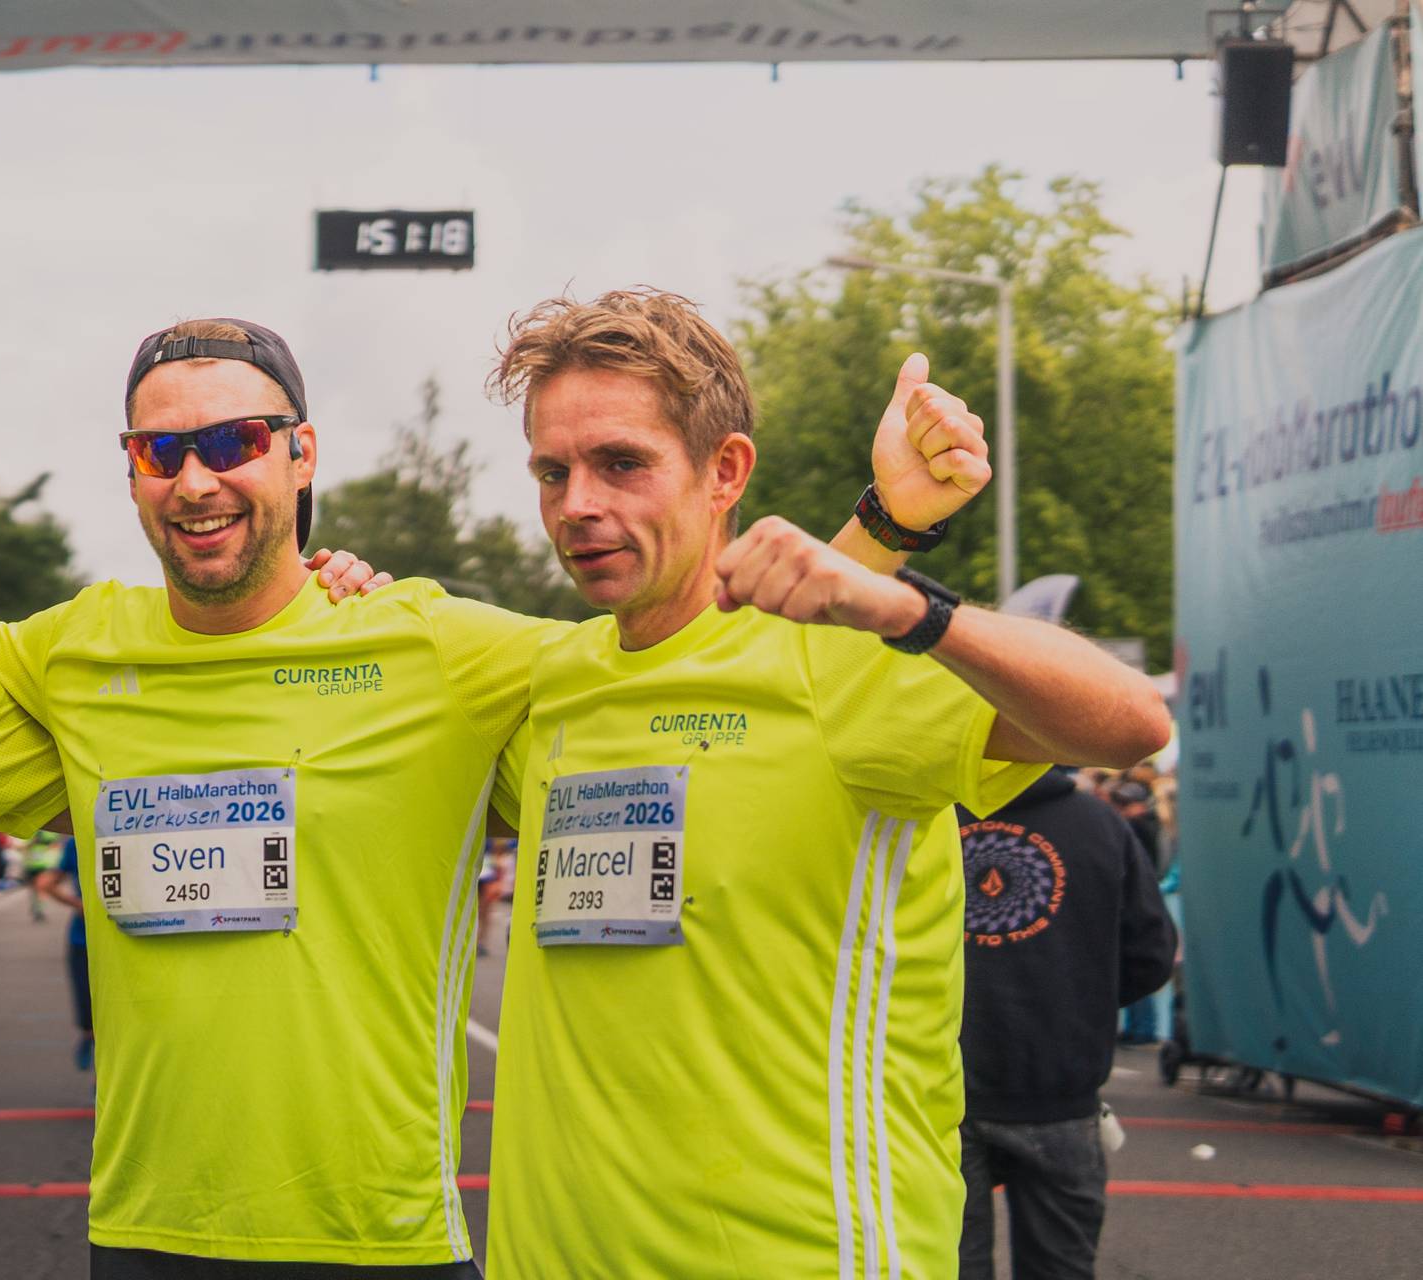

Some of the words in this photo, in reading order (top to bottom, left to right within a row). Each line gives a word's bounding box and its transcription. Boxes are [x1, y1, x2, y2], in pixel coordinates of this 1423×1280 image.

[273, 663, 382, 685] CURRENTA
[317, 680, 383, 696] GRUPPE
[650, 713, 748, 733] CURRENTA
[108, 787, 156, 812] EVL
[157, 780, 278, 802] HalbMarathon
[548, 786, 575, 813] EVL
[577, 779, 669, 801] HalbMarathon
[113, 809, 220, 832] Leverkusen
[226, 801, 286, 823] 2026
[547, 810, 621, 834] Leverkusen
[624, 802, 675, 826] 2026
[151, 843, 225, 873] Sven
[555, 842, 635, 879] Marcel
[1027, 832, 1067, 914] COMPANY
[165, 883, 210, 902] 2450
[568, 890, 604, 910] 2393
[976, 934, 1002, 946] TO
